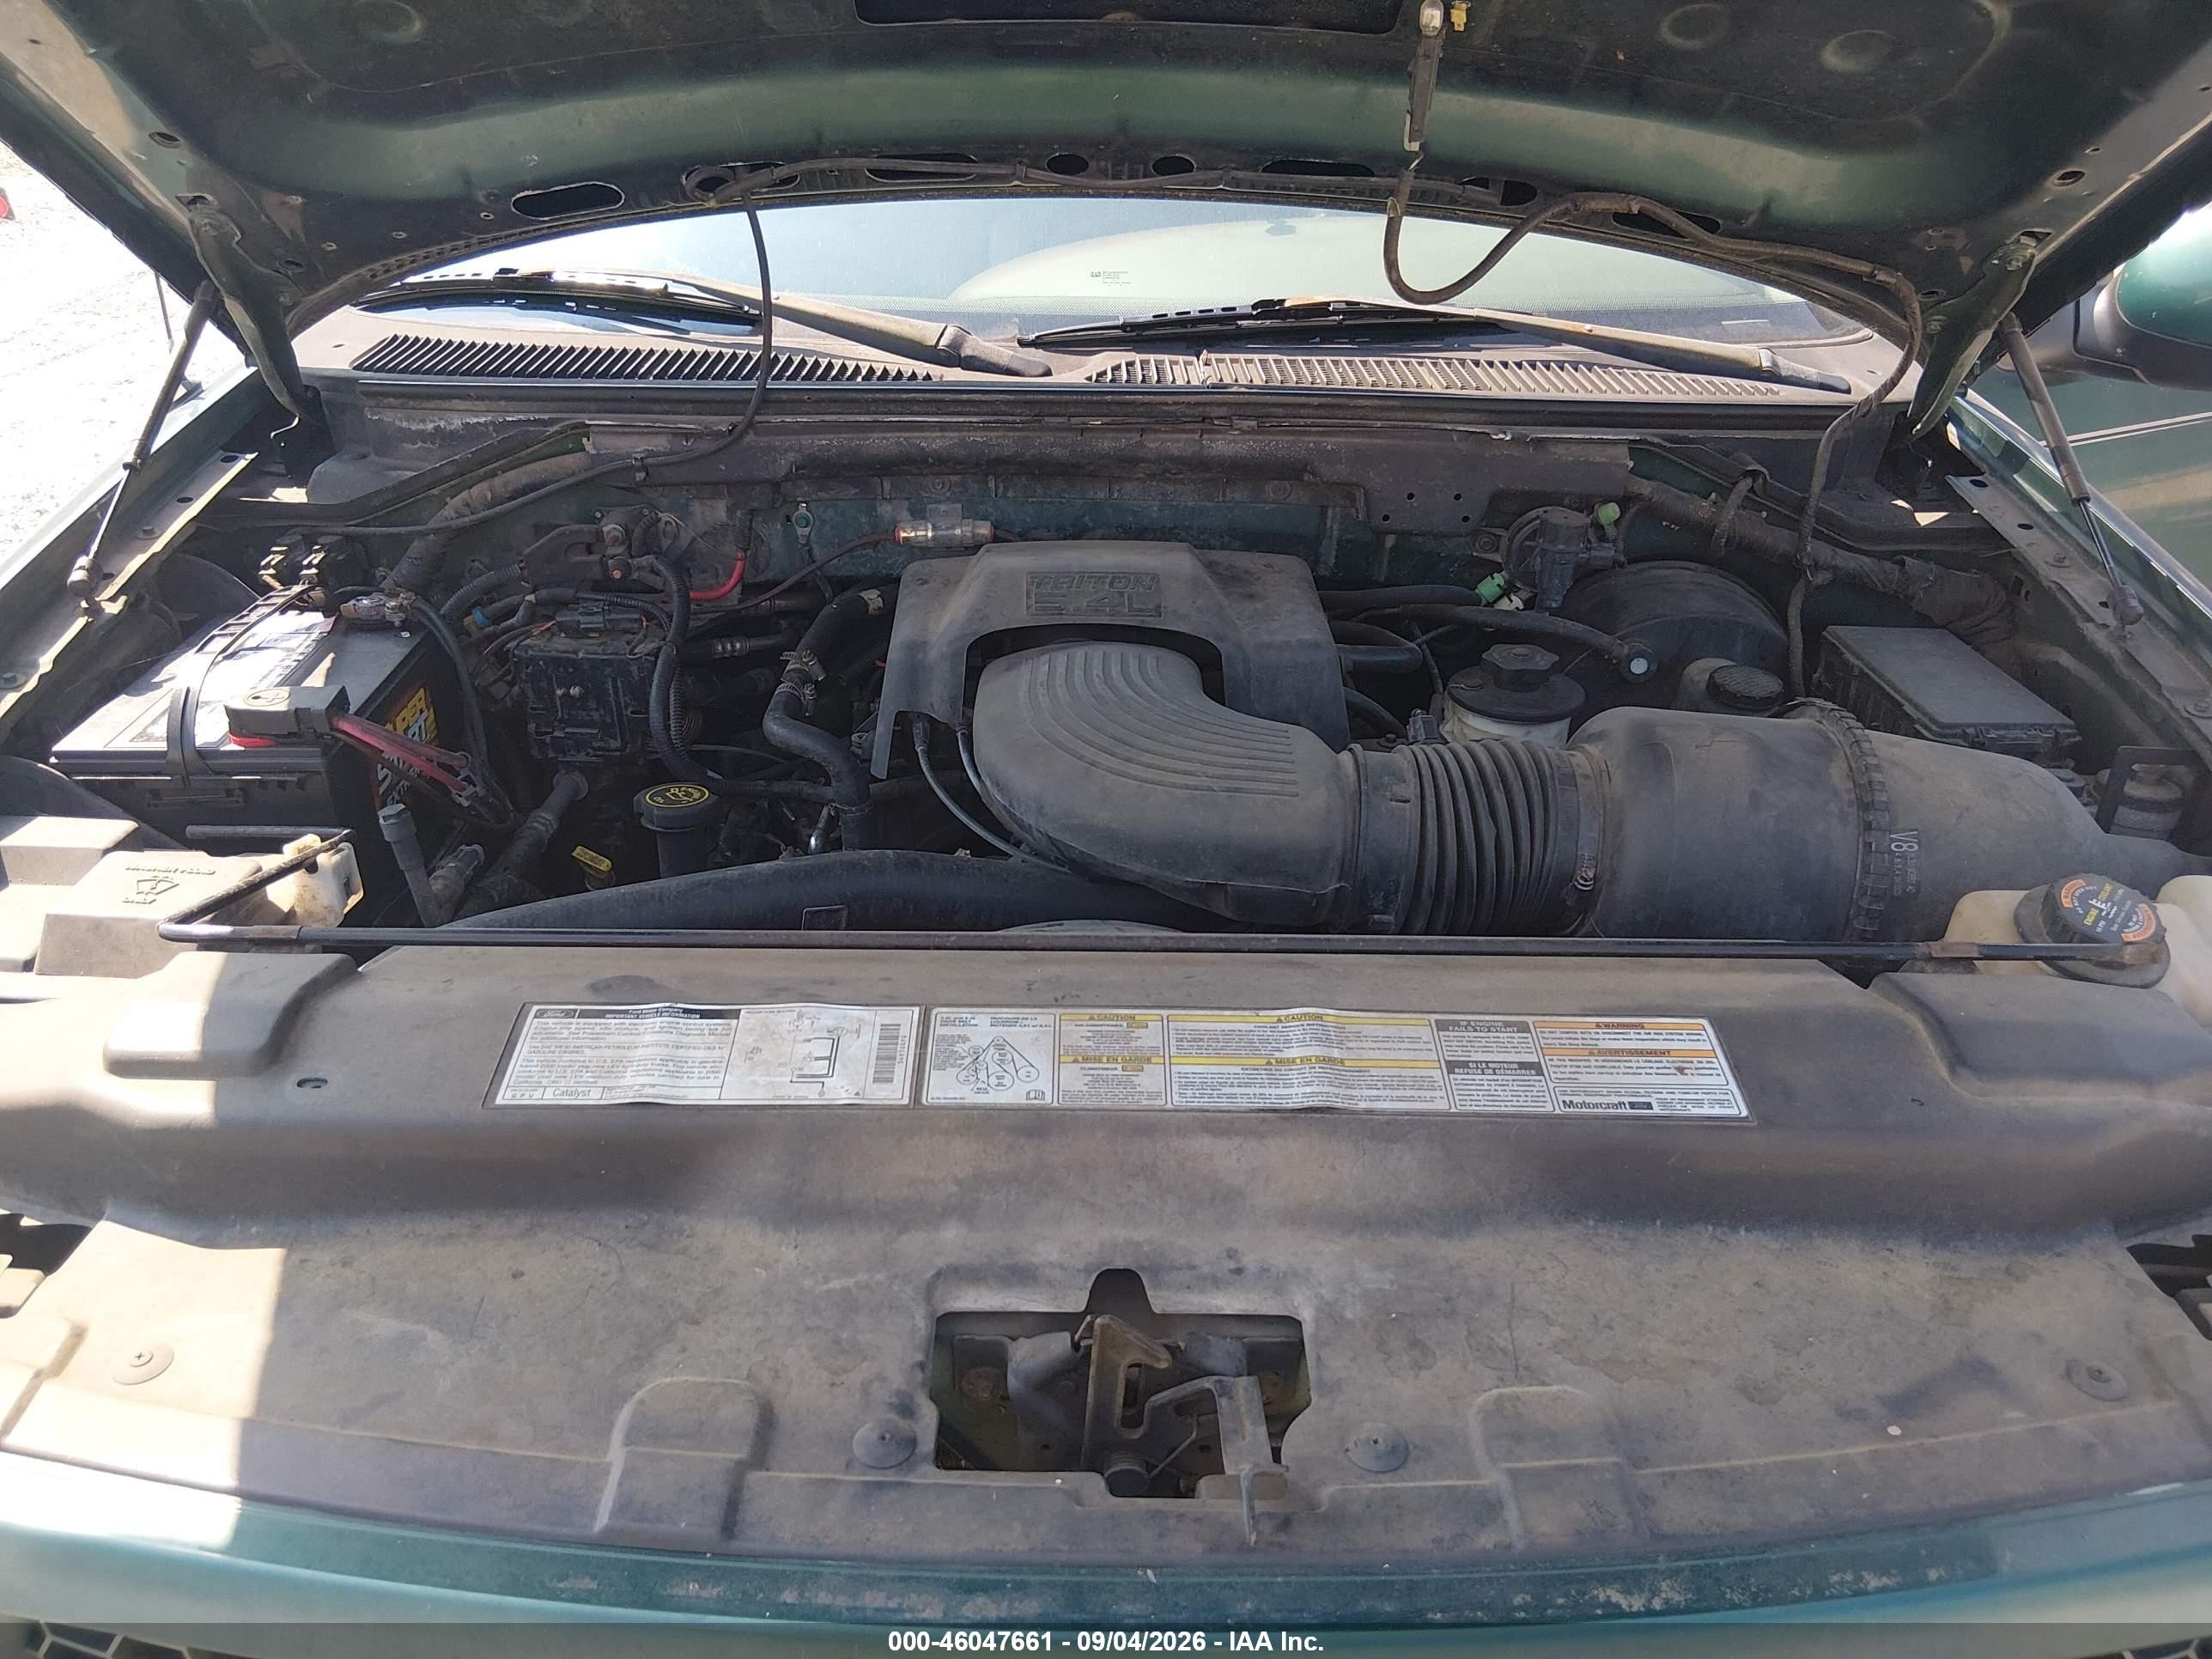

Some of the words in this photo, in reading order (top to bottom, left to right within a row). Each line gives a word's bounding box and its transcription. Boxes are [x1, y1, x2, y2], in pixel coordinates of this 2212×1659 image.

[1030, 574, 1157, 591] TRITON
[1034, 592, 1156, 613] 5.4L
[1889, 830, 1919, 852] V8
[2083, 907, 2099, 926] ENGINE
[552, 1088, 592, 1098] Catalyst
[1562, 1099, 1628, 1110] Motorcraft
